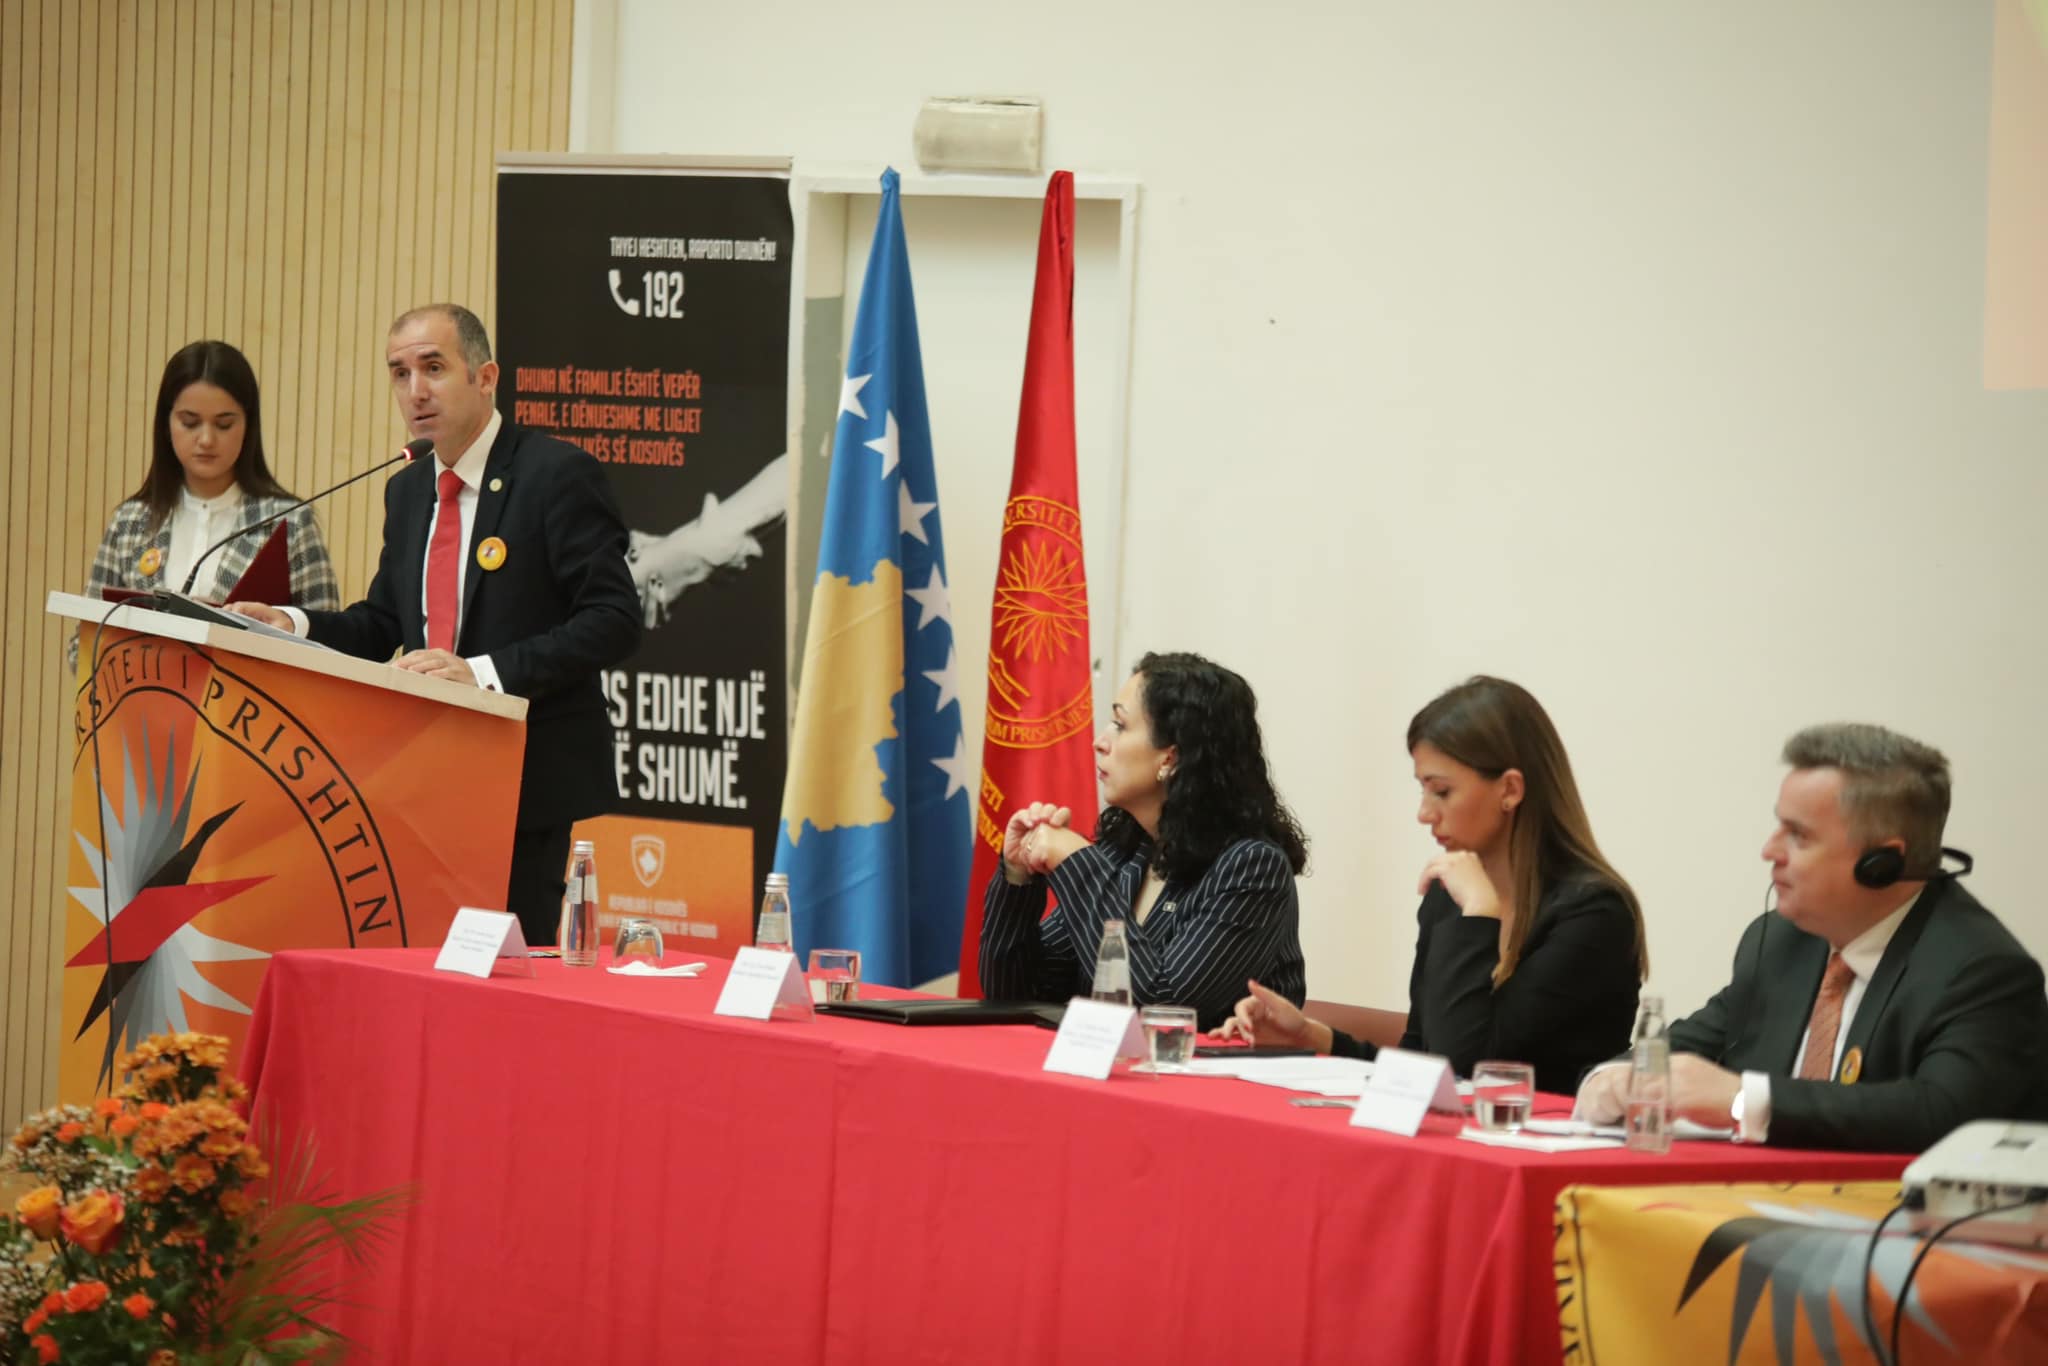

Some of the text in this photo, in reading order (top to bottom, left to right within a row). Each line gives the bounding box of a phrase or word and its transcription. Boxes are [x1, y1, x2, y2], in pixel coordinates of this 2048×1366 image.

[642, 271, 684, 318] 192
[516, 364, 702, 399] DHUNA NË FAMILJE ËSHTË VEPËR
[514, 398, 703, 433] PENALE, E DËNUESHME ME LIGJET
[612, 434, 628, 463] SË
[628, 436, 685, 467] KOSOVËS
[636, 672, 709, 735] EDHE
[715, 670, 766, 740] NJË
[637, 740, 748, 809] SHUMË.
